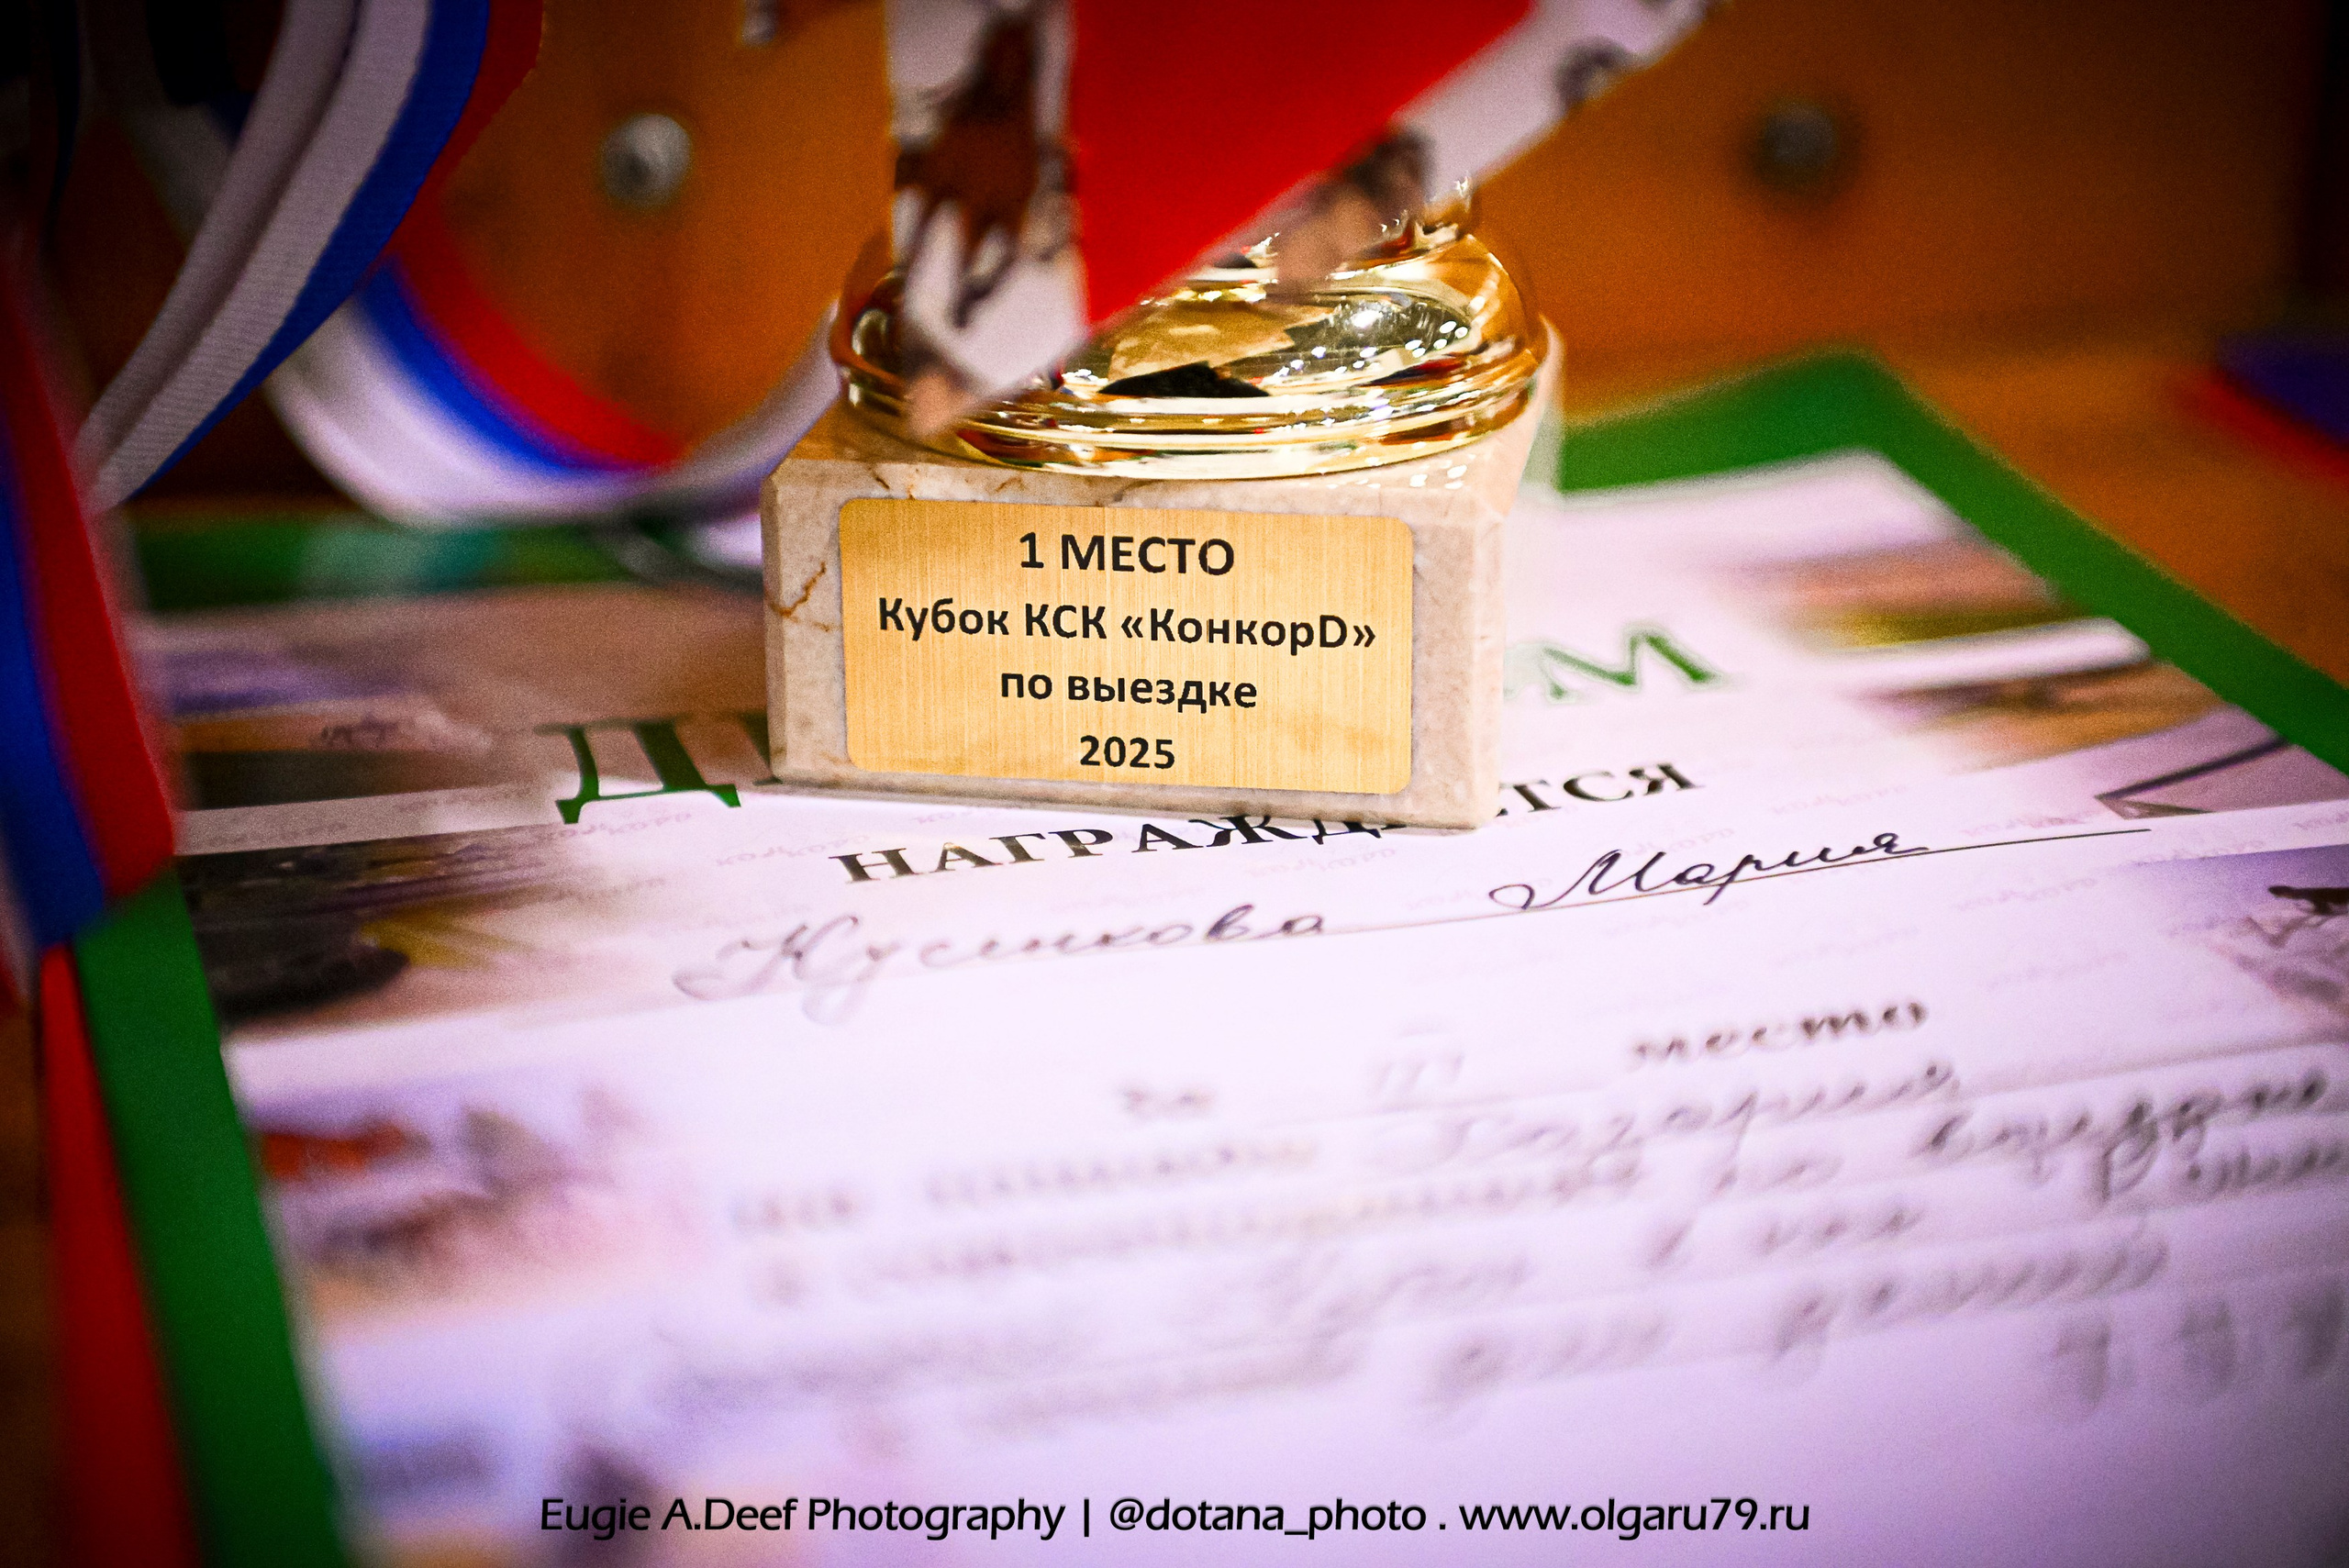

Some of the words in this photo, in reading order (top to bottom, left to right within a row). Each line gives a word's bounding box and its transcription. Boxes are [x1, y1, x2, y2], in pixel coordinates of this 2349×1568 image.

[1019, 530, 1045, 570] 1
[1060, 533, 1235, 577] МЕСТО
[878, 596, 1010, 642] Кубок
[1024, 602, 1108, 640] КСК
[1119, 606, 1376, 657] «КонкорD»
[1000, 672, 1053, 701] по
[1067, 674, 1258, 715] выездке
[1079, 734, 1176, 771] 2025
